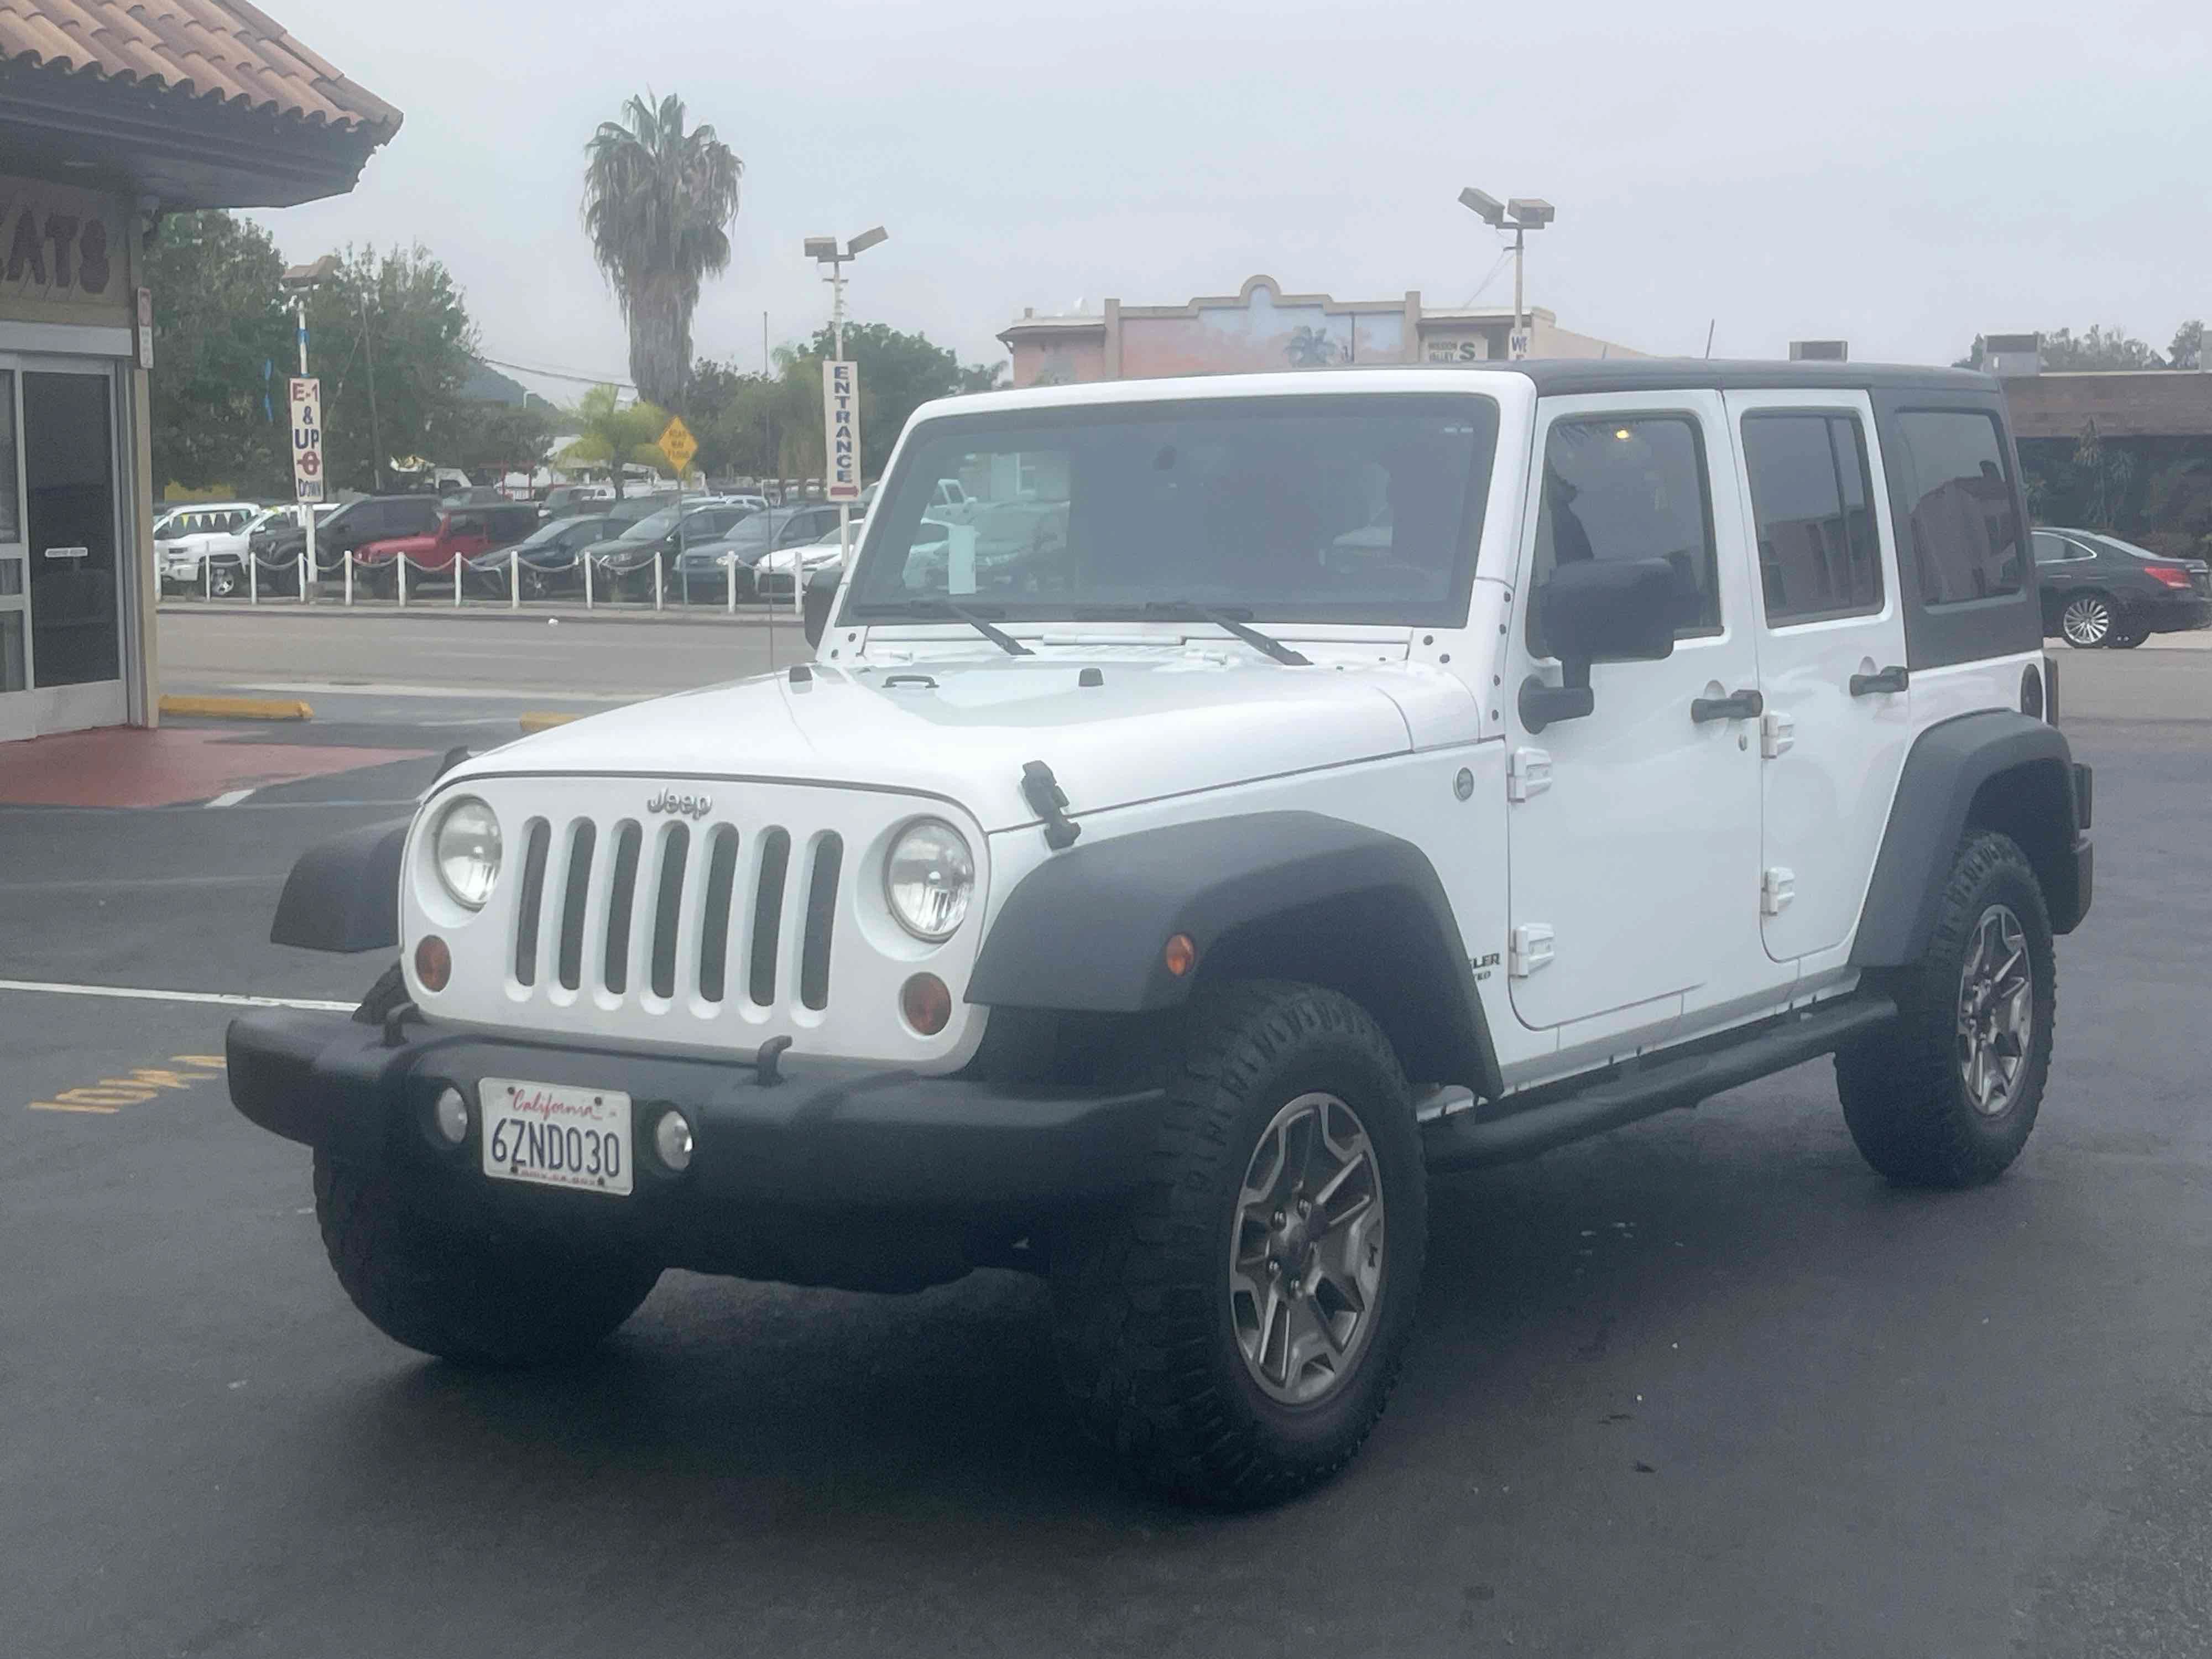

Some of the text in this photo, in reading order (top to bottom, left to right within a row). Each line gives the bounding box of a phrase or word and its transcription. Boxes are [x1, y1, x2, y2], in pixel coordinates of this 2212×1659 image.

[294, 429, 319, 450] UP
[834, 366, 853, 484] ENTRANCE
[646, 786, 713, 821] Jeep
[513, 1088, 603, 1121] California
[492, 1118, 620, 1177] 6ZND030
